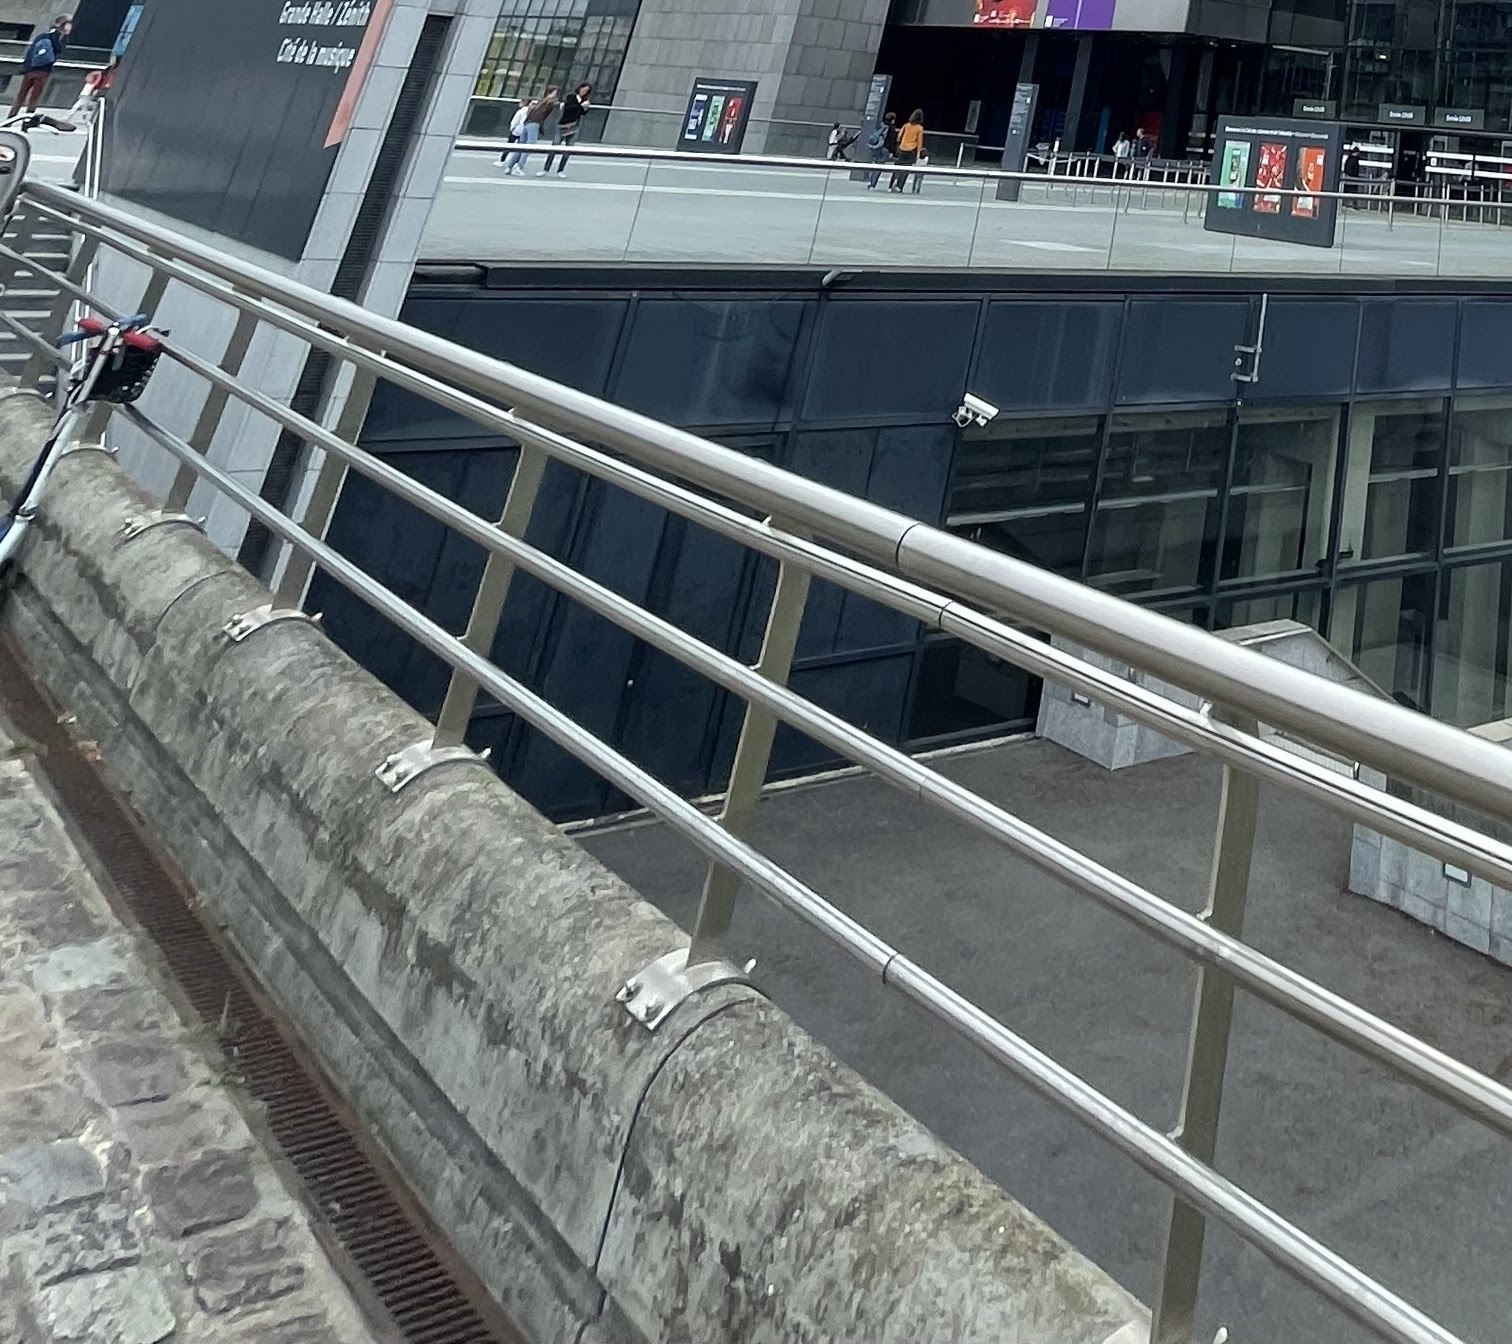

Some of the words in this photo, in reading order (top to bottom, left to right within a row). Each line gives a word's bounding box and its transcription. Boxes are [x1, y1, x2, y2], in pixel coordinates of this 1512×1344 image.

[279, 1, 311, 24] Grande
[308, 1, 333, 25] Halle
[336, 0, 371, 25] Zénith
[277, 38, 300, 62] Cité
[294, 39, 308, 63] de
[306, 40, 318, 64] la
[315, 41, 355, 74] musique
